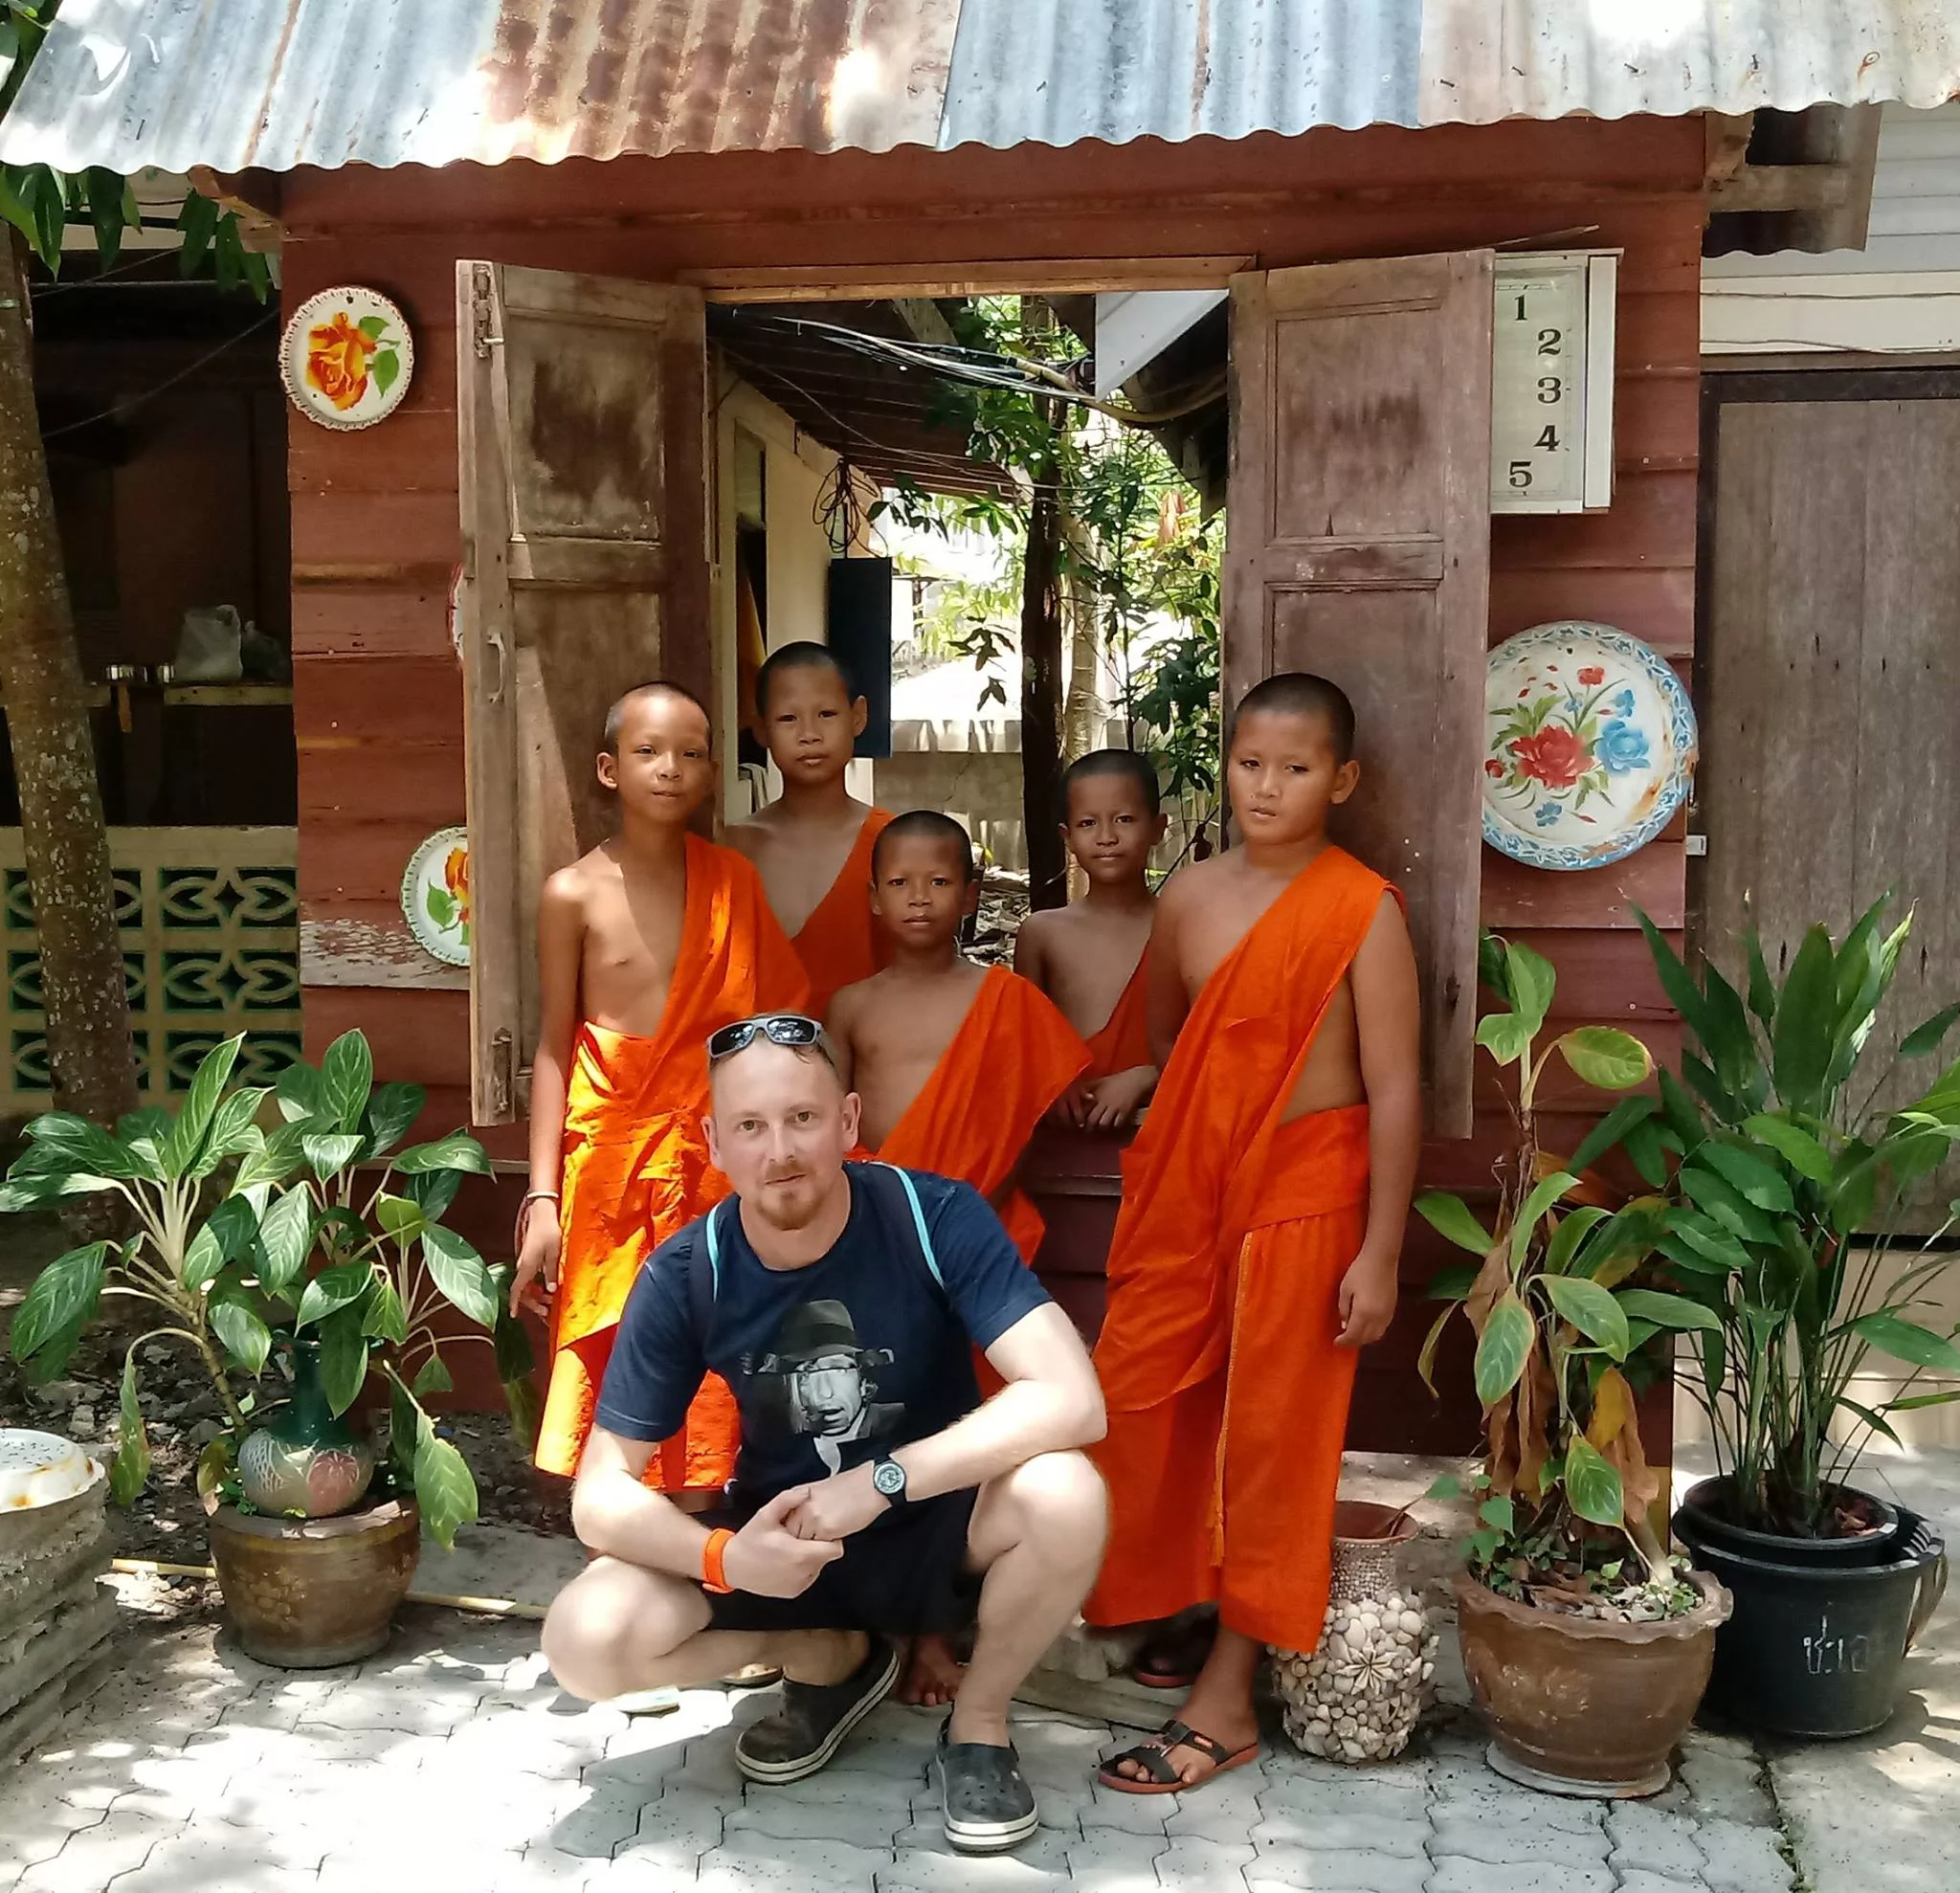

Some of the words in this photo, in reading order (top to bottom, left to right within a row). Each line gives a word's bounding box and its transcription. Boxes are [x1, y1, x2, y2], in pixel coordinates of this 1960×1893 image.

[1514, 295, 1527, 321] 1
[1537, 329, 1562, 355] 2
[1537, 377, 1562, 404] 3
[1533, 425, 1560, 452] 4
[1509, 460, 1532, 487] 5
